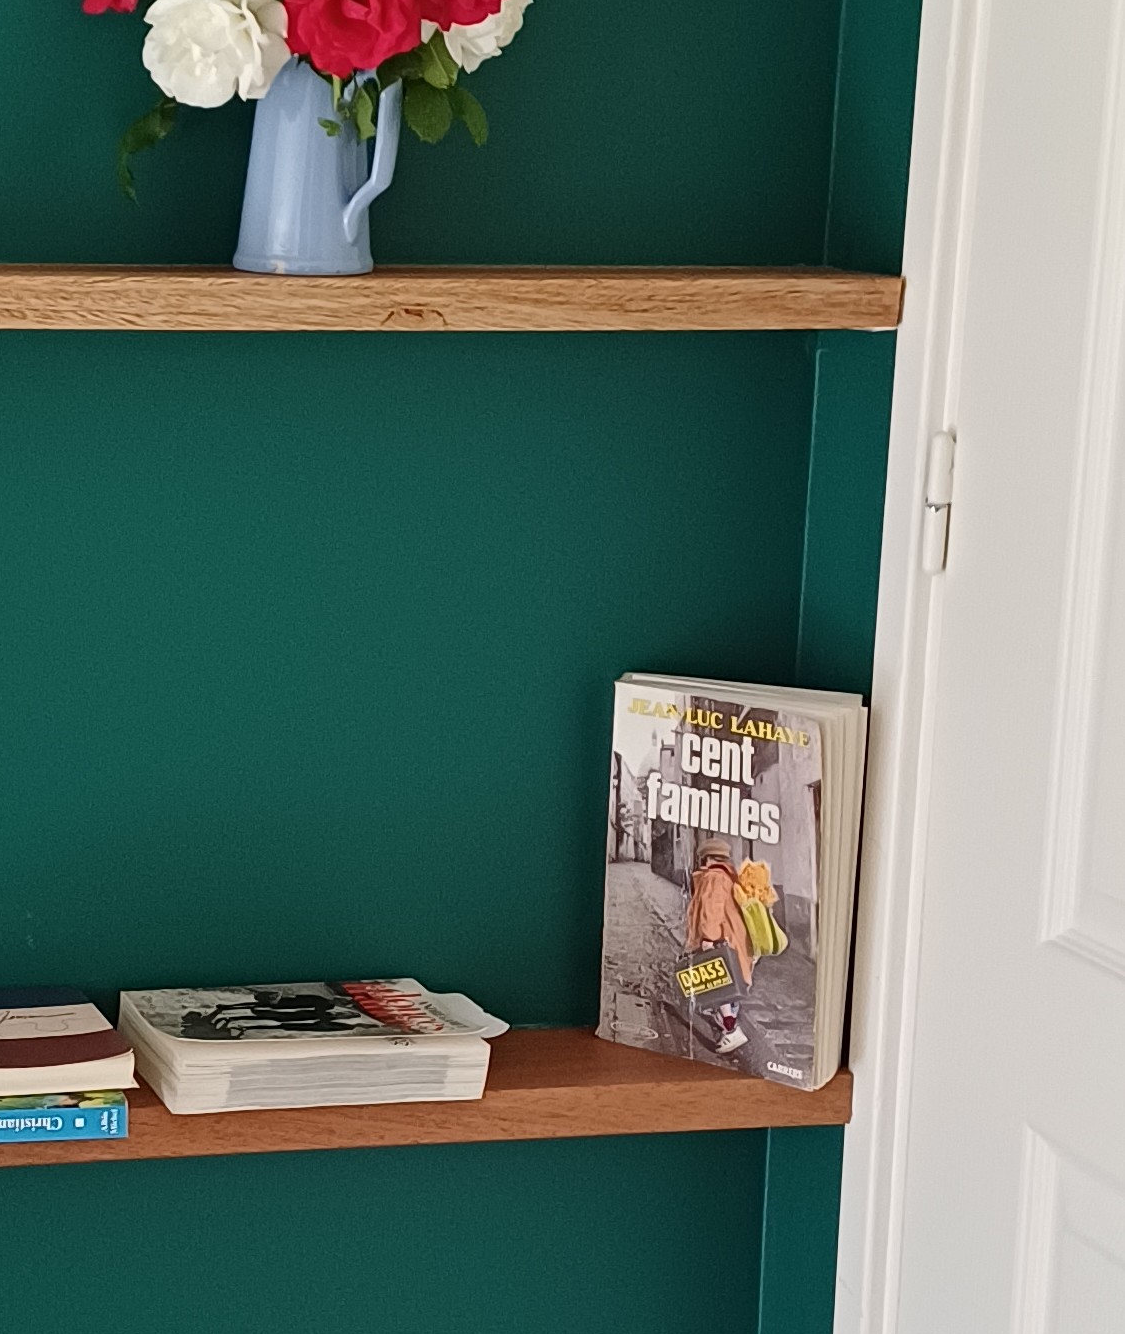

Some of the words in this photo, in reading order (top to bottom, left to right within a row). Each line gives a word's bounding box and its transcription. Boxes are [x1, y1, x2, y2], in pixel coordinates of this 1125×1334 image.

[681, 732, 755, 786] cent
[730, 716, 811, 748] LAHAYE
[646, 771, 780, 844] familles
